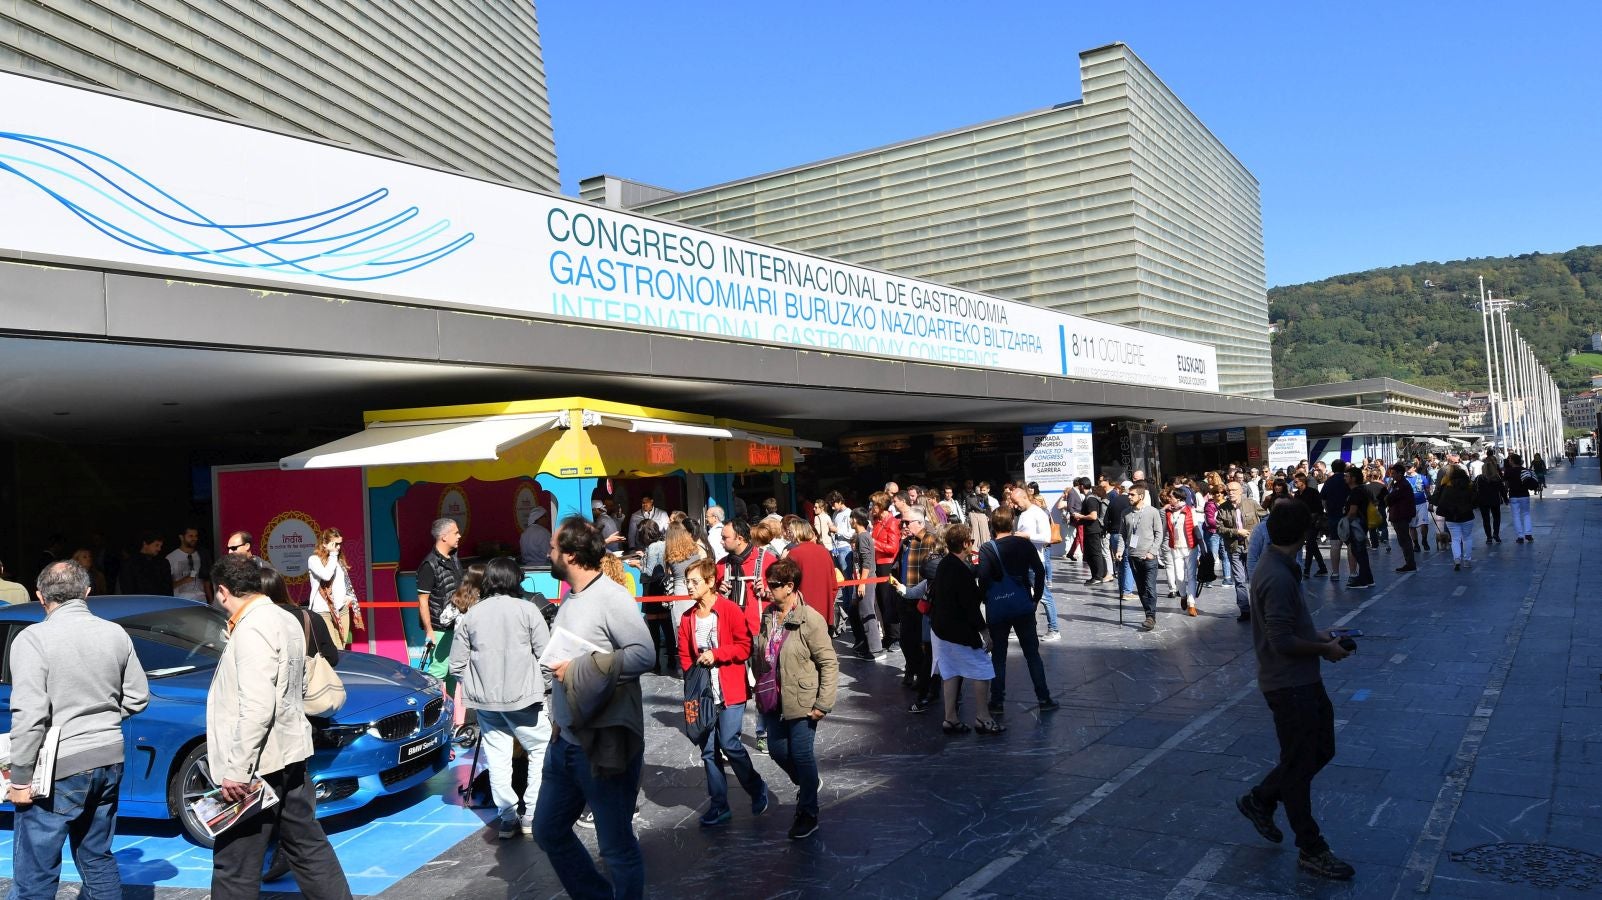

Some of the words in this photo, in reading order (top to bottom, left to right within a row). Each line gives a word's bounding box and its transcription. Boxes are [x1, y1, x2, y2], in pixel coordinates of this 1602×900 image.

[547, 207, 715, 270] CONGRESO
[722, 245, 882, 302] INTERNACIONAL
[886, 281, 907, 306] DE
[911, 286, 1008, 325] GASTRONOMIA
[549, 250, 778, 316] GASTRONOMIARI
[785, 292, 876, 330] BURUZKO
[881, 309, 980, 345] NAZIOARTEKO
[984, 327, 1044, 354] BILTZARRA
[552, 292, 759, 339] INTERNATIONAL
[773, 324, 904, 353] GASTRONOMY
[908, 342, 1000, 367] CONFERENCE
[1099, 338, 1146, 366] OCTUBRE
[1177, 354, 1206, 375] EUSKADI
[1034, 435, 1060, 443] ENTRADA
[408, 744, 423, 756] BMW
